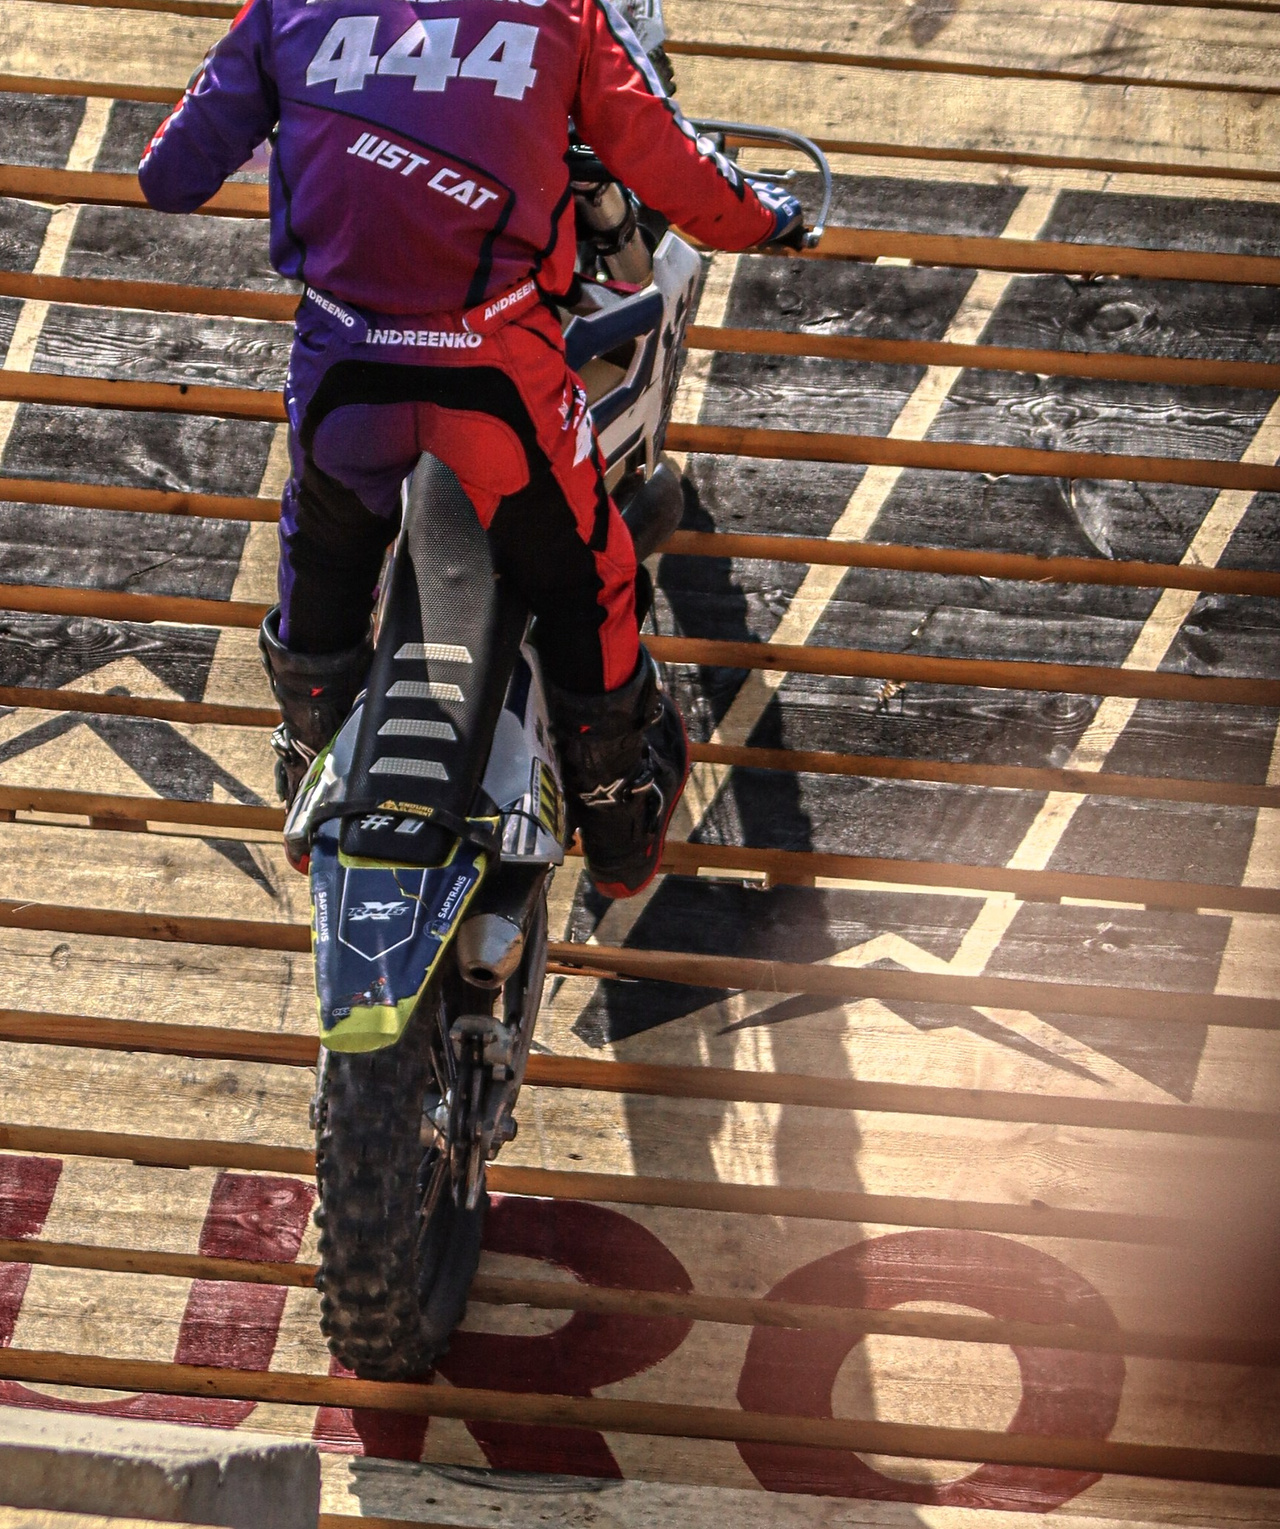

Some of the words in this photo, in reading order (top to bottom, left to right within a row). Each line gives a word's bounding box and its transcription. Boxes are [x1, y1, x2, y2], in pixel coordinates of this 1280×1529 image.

[305, 15, 540, 101] 444
[346, 131, 430, 176] JUST
[426, 167, 498, 211] CAT
[398, 801, 434, 813] ENDURO
[318, 891, 330, 942] SAPTRANS
[437, 875, 467, 919] SAPTRANS
